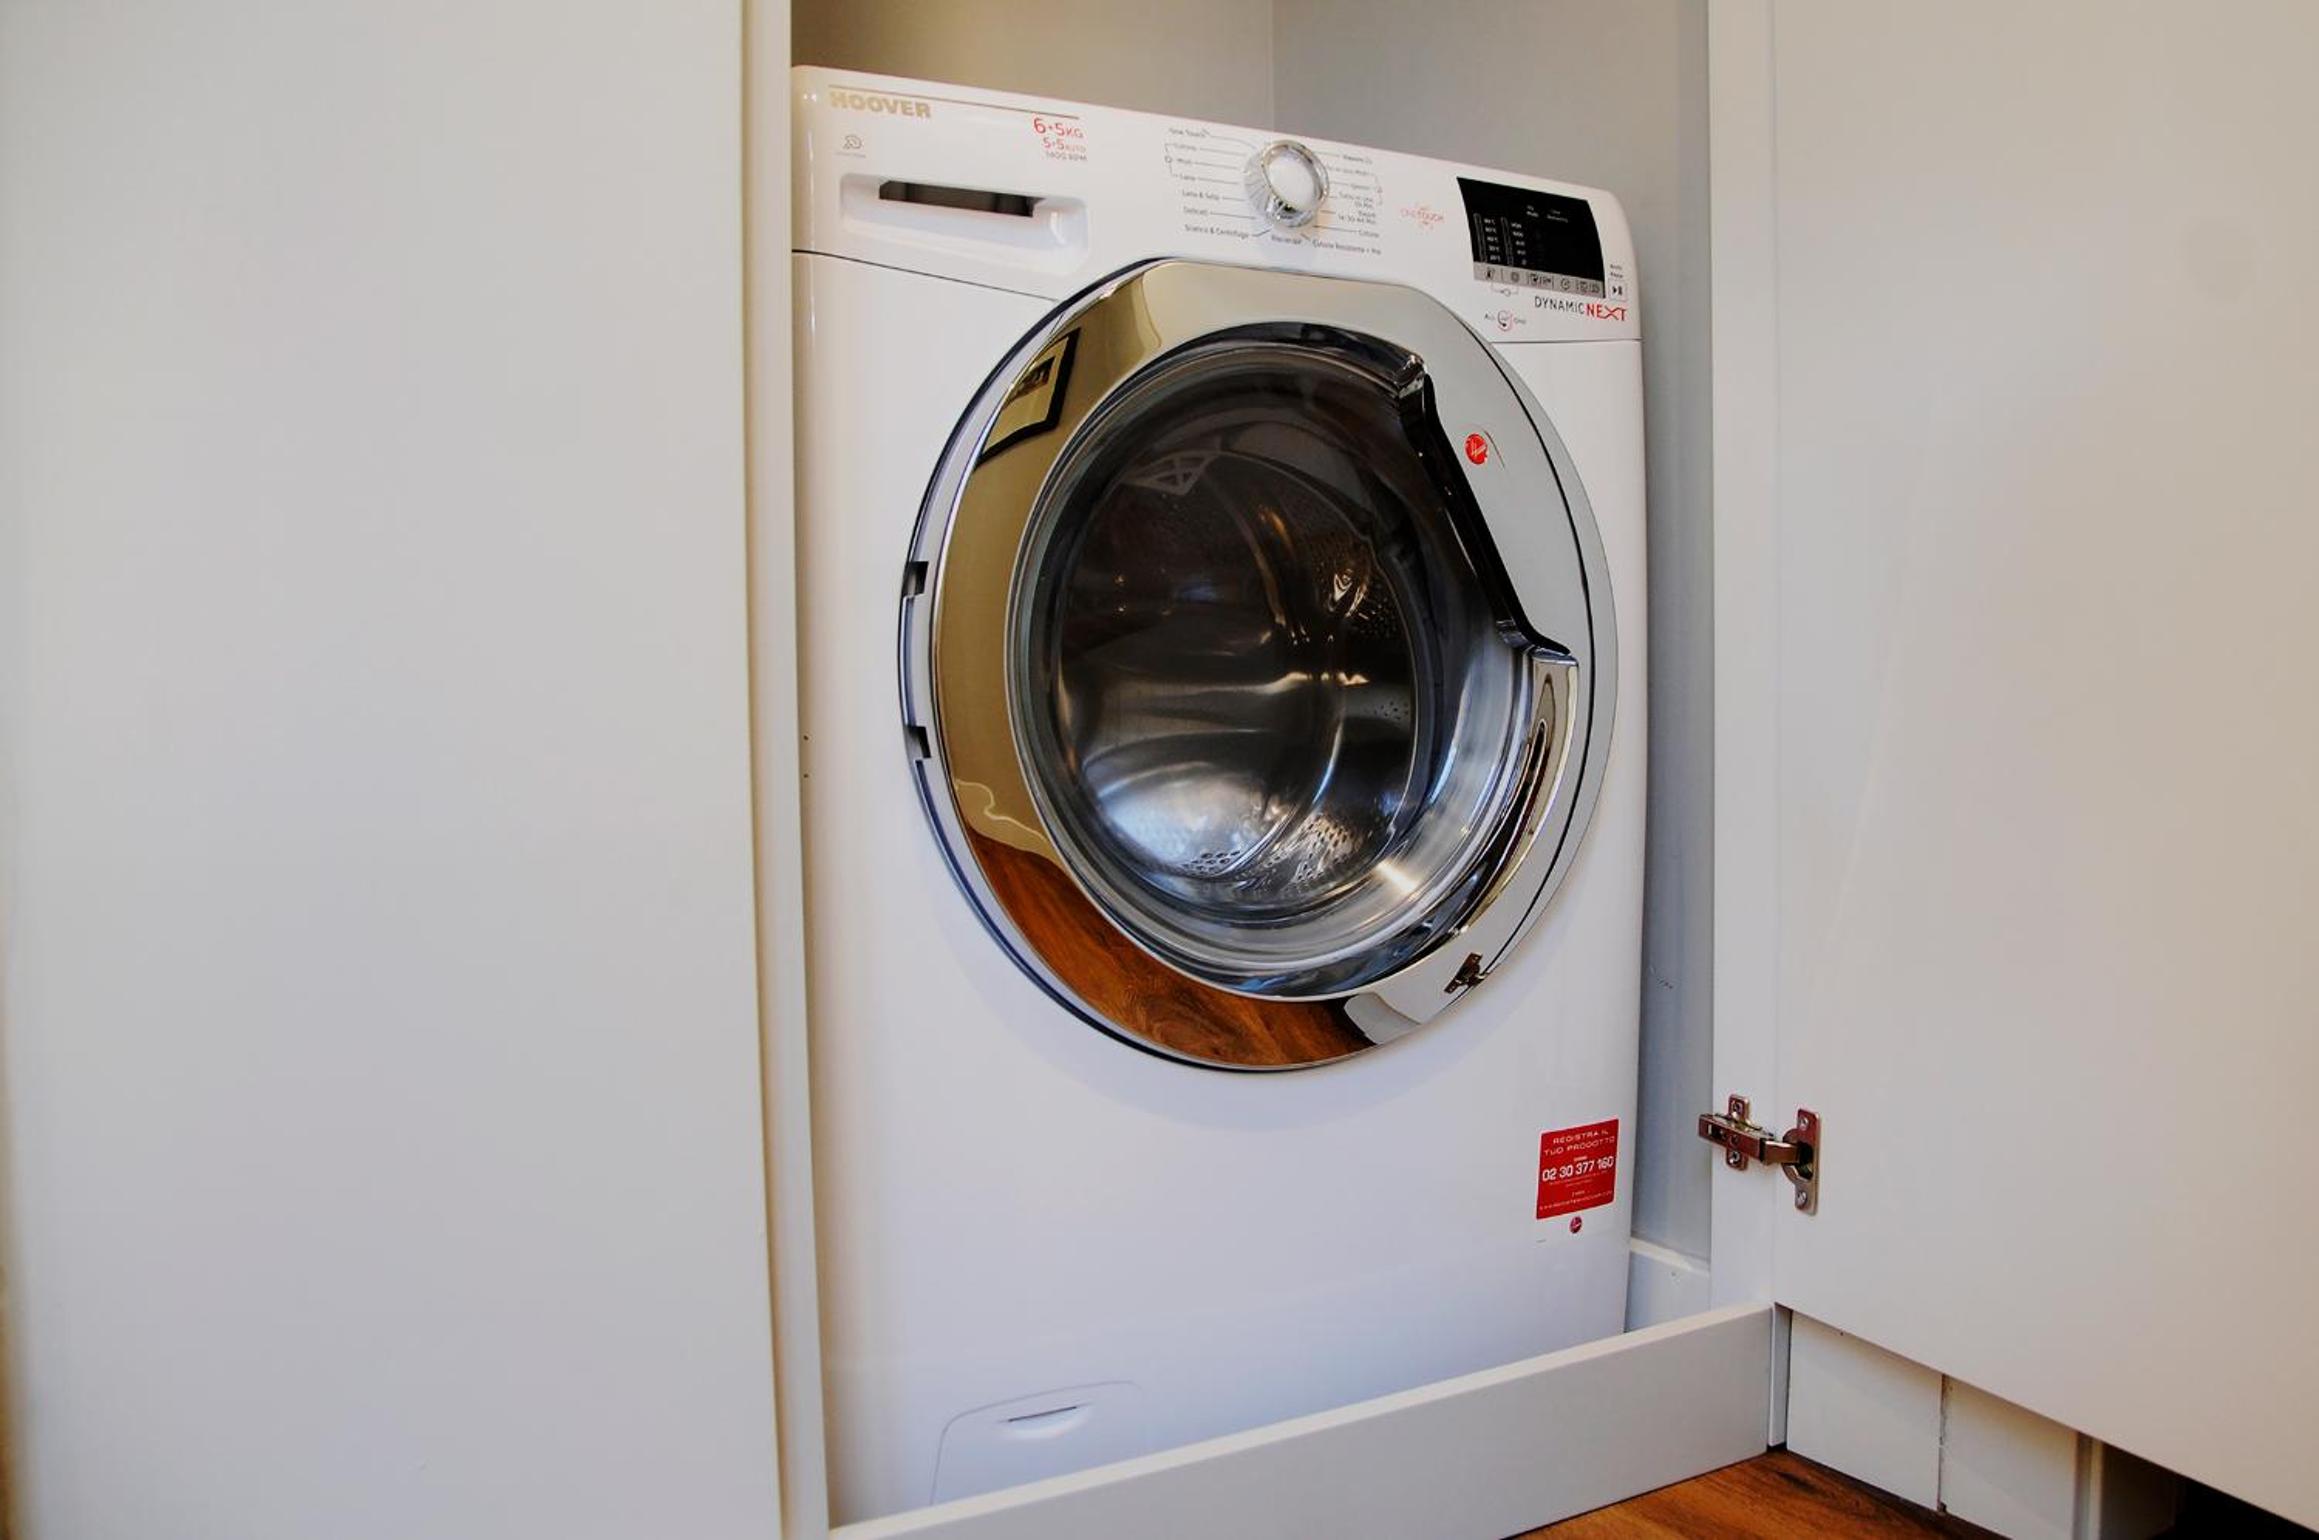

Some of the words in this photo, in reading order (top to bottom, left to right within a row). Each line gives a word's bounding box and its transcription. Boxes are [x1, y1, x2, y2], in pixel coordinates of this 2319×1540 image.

[830, 91, 931, 117] HOOVER
[1543, 1147, 1564, 1157] TUO
[1542, 1167, 1557, 1182] 02
[1559, 1164, 1574, 1179] 30
[1575, 1160, 1595, 1175] 377
